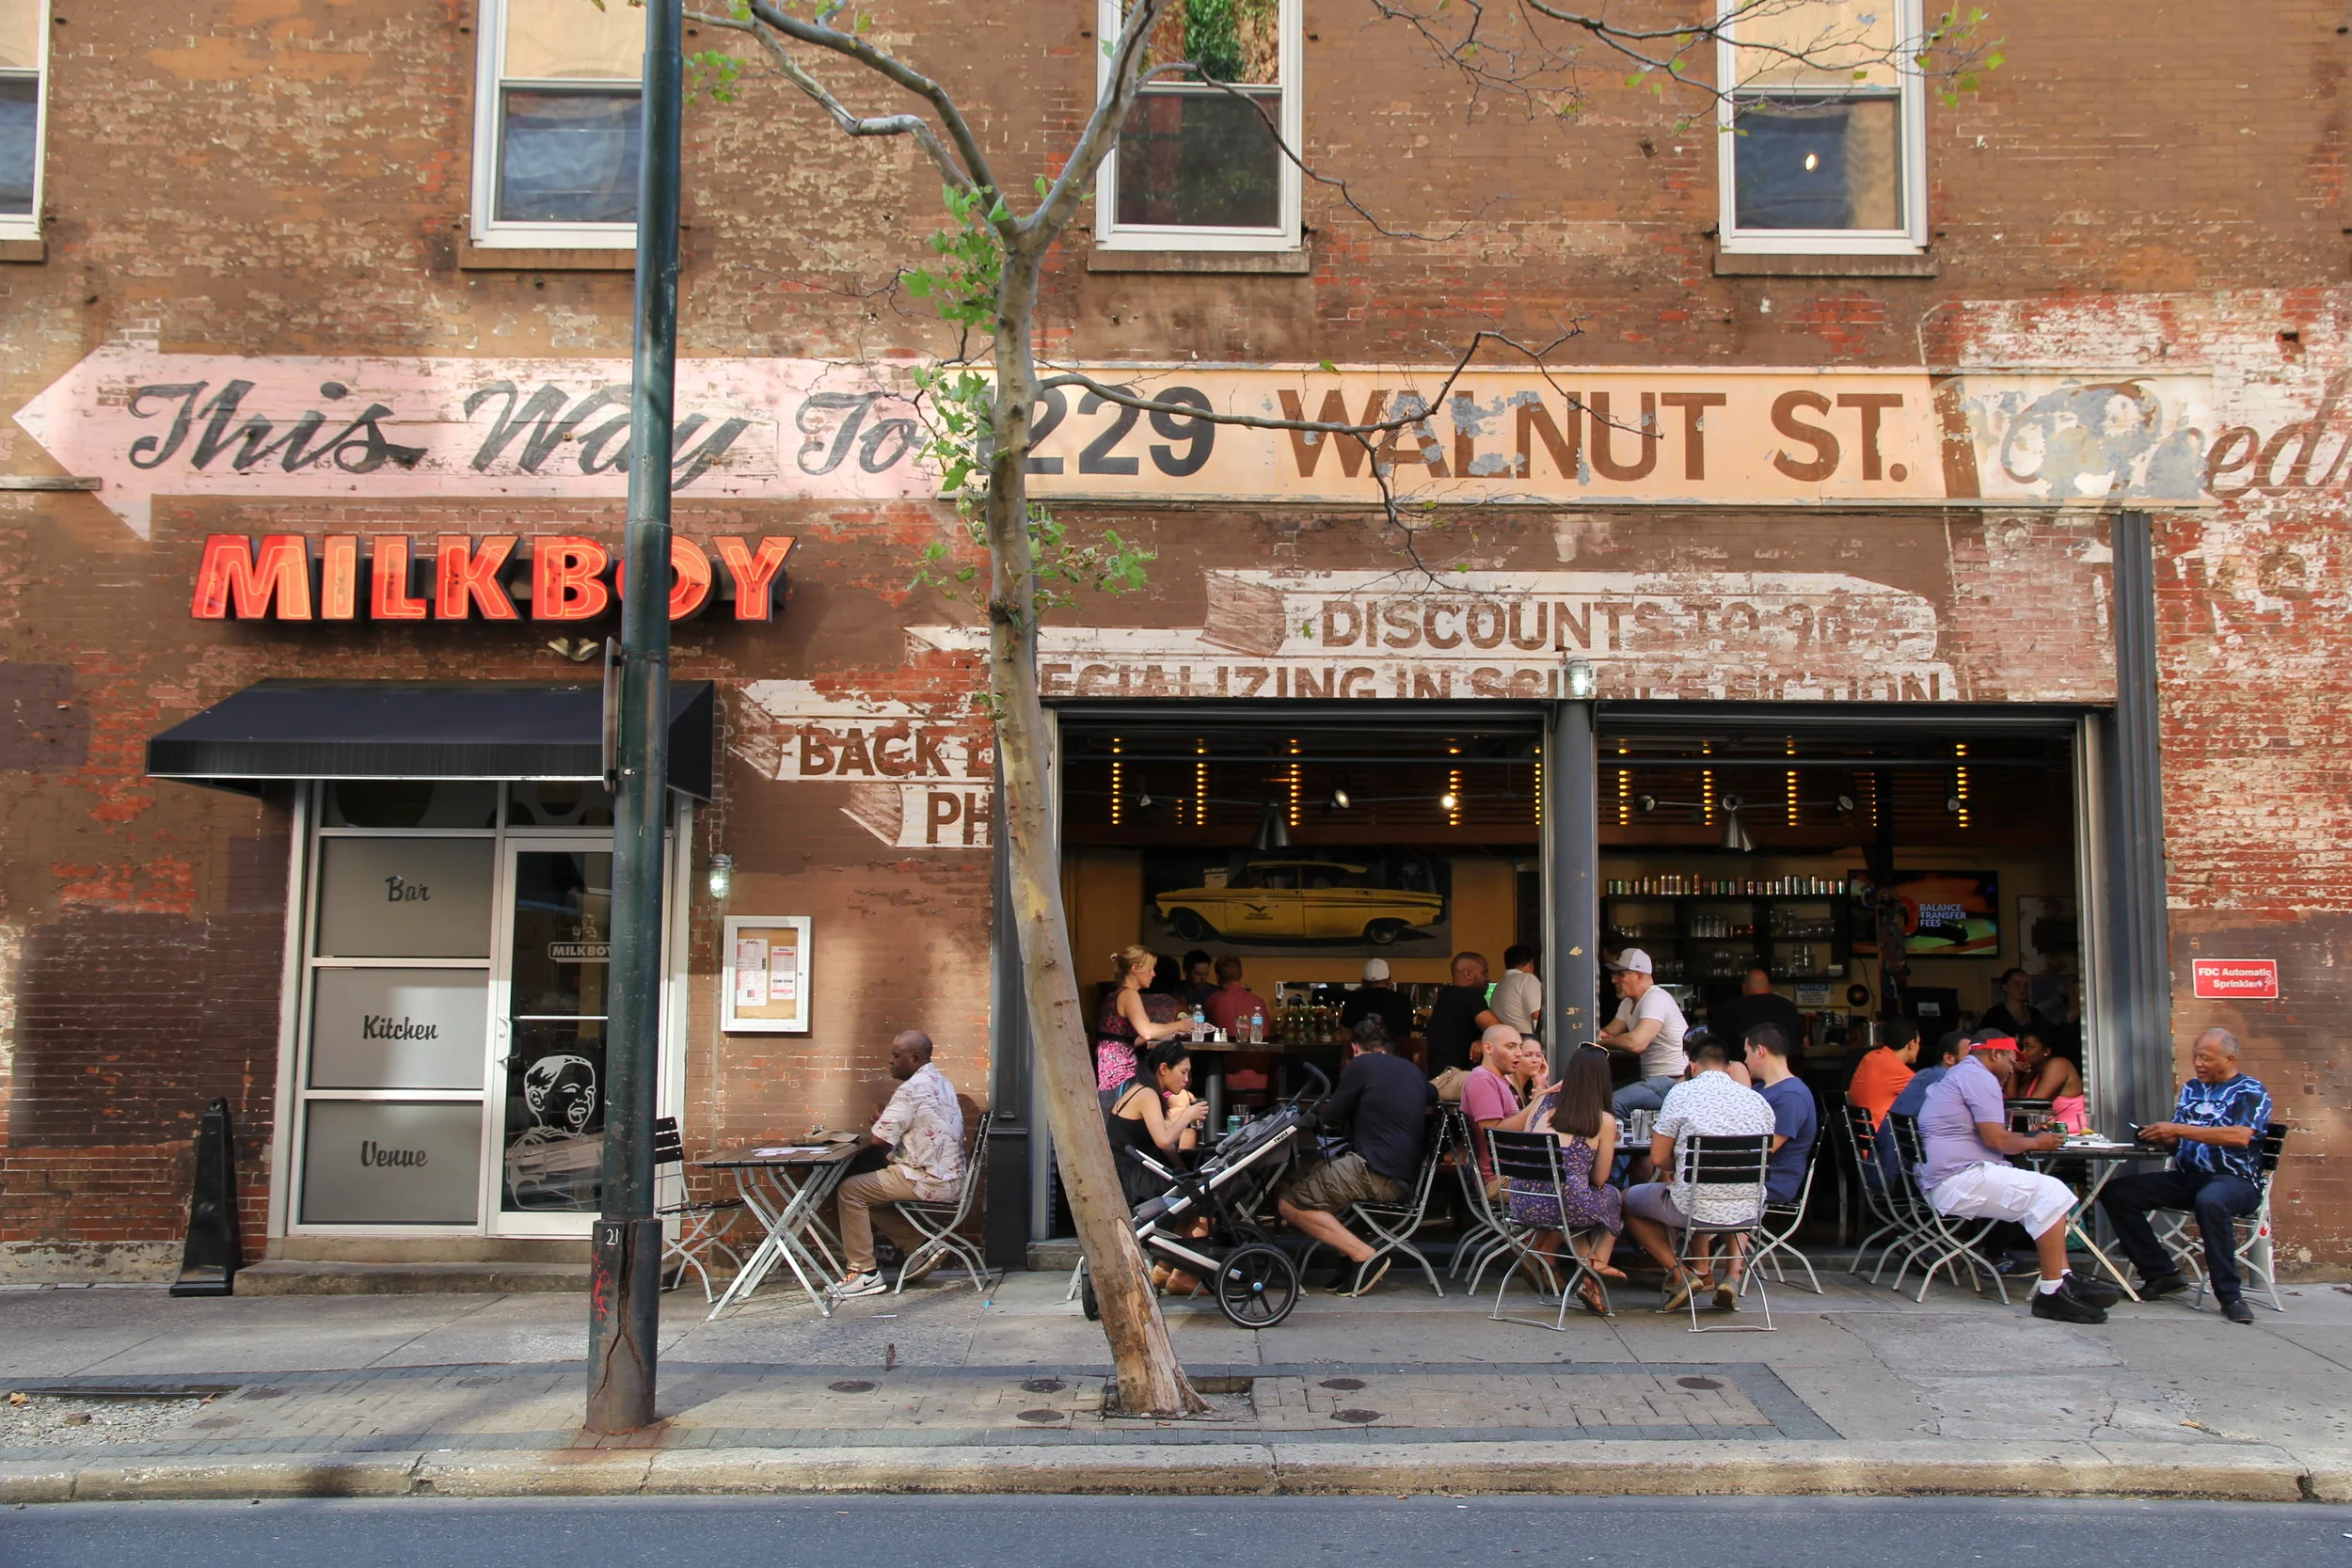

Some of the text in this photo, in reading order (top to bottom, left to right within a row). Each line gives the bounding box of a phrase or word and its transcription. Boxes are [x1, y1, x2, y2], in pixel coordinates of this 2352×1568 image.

[128, 379, 428, 474] This
[795, 390, 928, 476] To
[1277, 388, 1726, 482] WALNUT
[1771, 389, 1910, 483] ST.
[798, 727, 952, 777] BACK
[385, 876, 431, 903] Bar
[2198, 968, 2272, 976] FDC Automatic
[362, 1015, 438, 1041] Kitchen
[360, 1140, 428, 1168] Venue
[606, 1227, 619, 1246] 21
